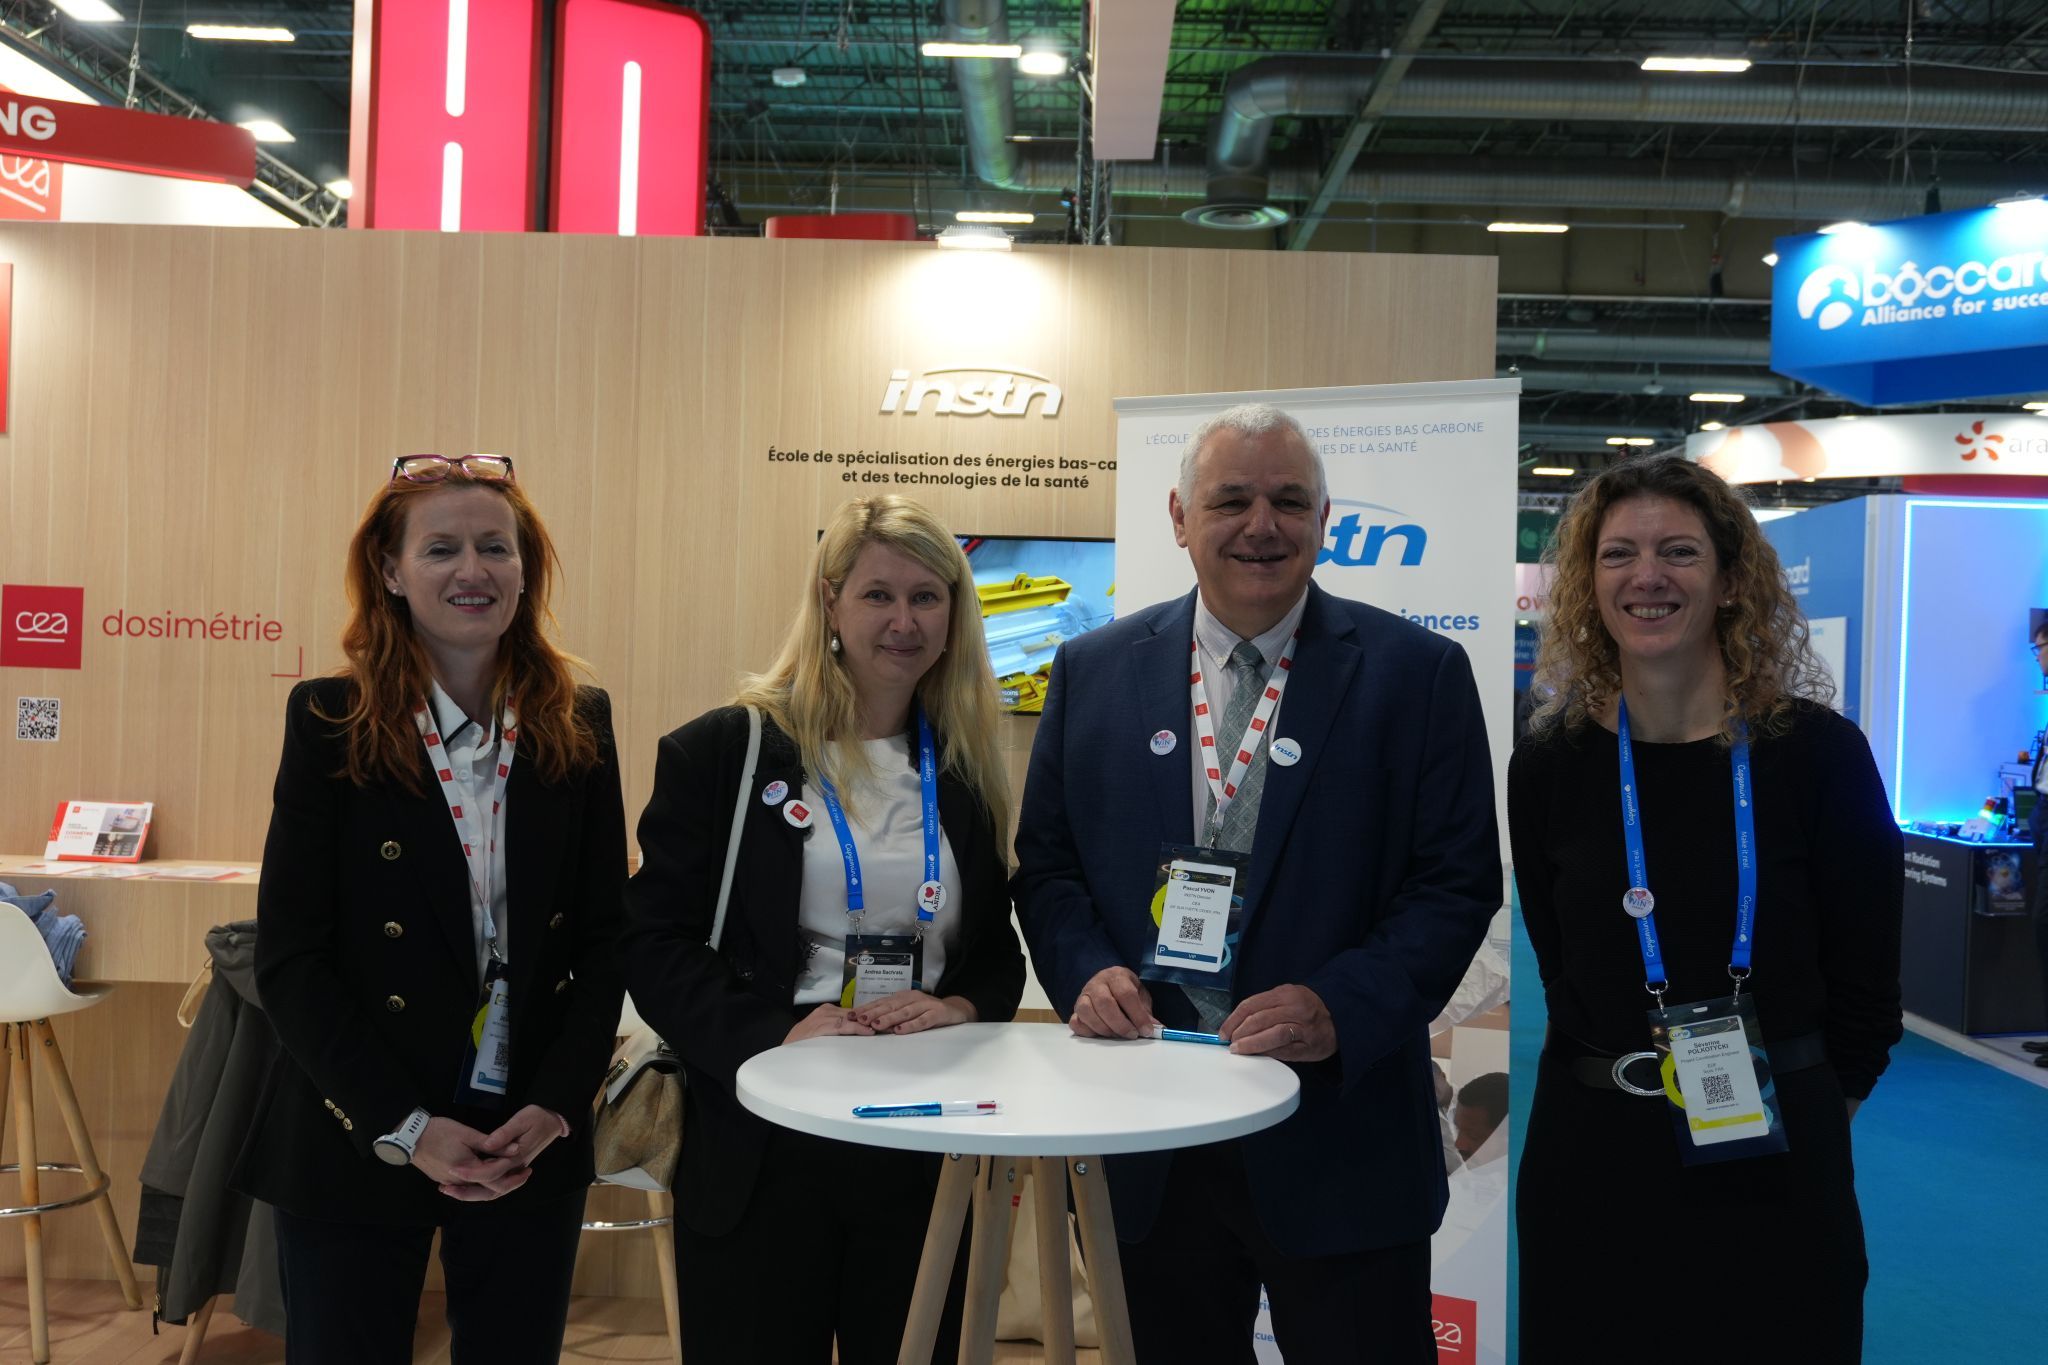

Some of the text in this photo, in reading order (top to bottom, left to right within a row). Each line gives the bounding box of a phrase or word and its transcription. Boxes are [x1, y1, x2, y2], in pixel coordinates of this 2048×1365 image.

[1861, 304, 1946, 326] Alliance
[1952, 296, 1986, 316] for
[879, 368, 1065, 418] instn
[1307, 427, 1330, 438] DES
[1333, 425, 1392, 438] ÉNERGIES
[1395, 424, 1418, 436] BAS
[1422, 421, 1485, 435] CARBONE
[768, 446, 810, 463] École
[813, 450, 833, 463] de
[837, 450, 949, 468] spécialisation
[953, 453, 982, 467] des
[985, 453, 1055, 472] énergies
[1341, 443, 1356, 454] DE
[1360, 442, 1375, 453] LA
[1378, 440, 1418, 453] SANTÉ
[841, 470, 1090, 490] et des technologies de la santé
[15, 610, 68, 635] cea
[102, 608, 283, 642] dosimétrie
